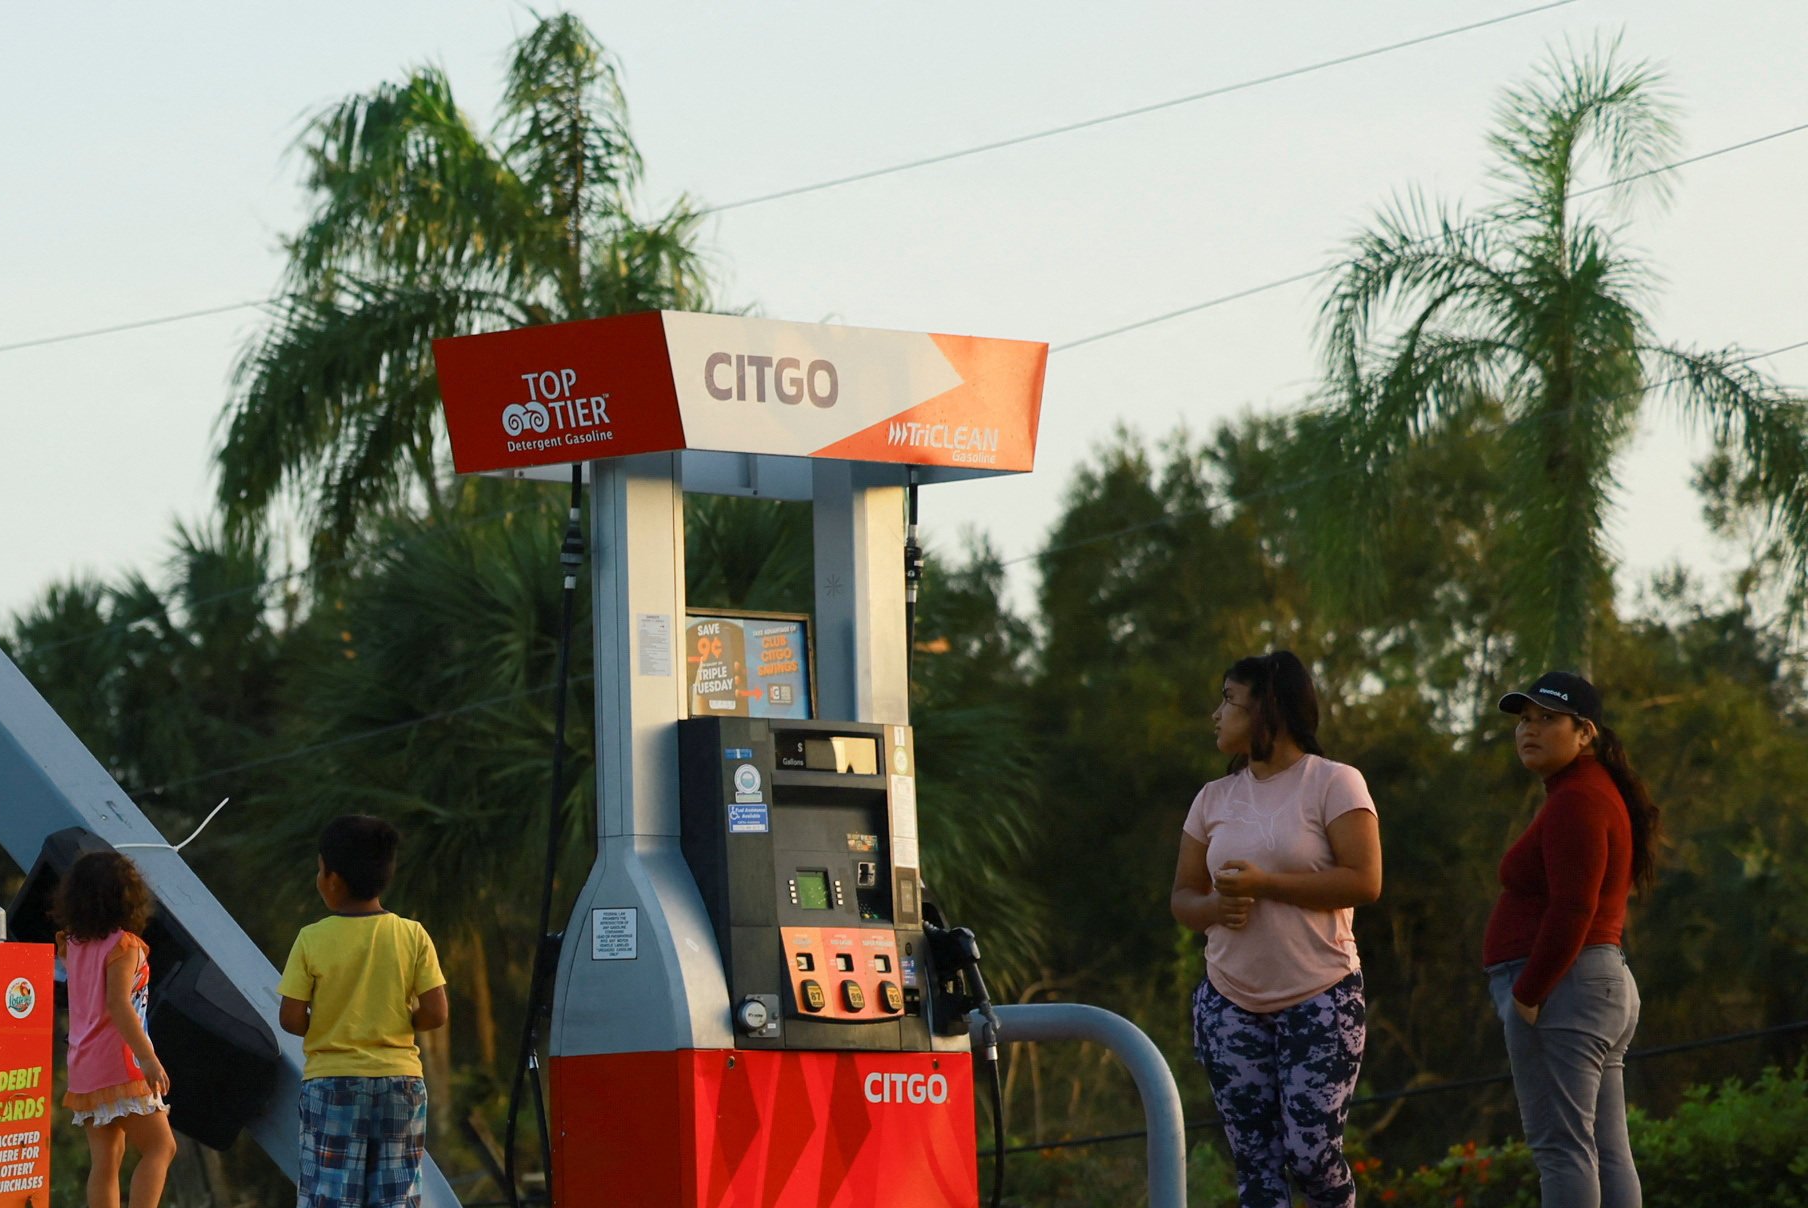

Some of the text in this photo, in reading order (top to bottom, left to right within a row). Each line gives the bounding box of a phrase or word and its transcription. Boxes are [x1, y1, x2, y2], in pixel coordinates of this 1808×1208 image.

[521, 368, 577, 401] TOP
[704, 351, 839, 409] CITGO
[548, 395, 610, 430] TIER
[507, 430, 614, 452] Detergent Gasoline
[906, 421, 1000, 452] TriCLEAN
[952, 450, 997, 464] Gasoline
[697, 624, 720, 636] SAVE
[697, 636, 722, 662] 9¢
[762, 635, 788, 649] CLUB
[761, 648, 792, 662] CITGO
[698, 666, 728, 680] TRIPLE
[757, 661, 798, 677] SAVINGS
[692, 678, 734, 694] TUESDAY
[782, 757, 804, 766] Gallons
[8, 994, 32, 1008] Lottery
[864, 1072, 948, 1104] CITGO
[21, 1146, 40, 1160] FOR
